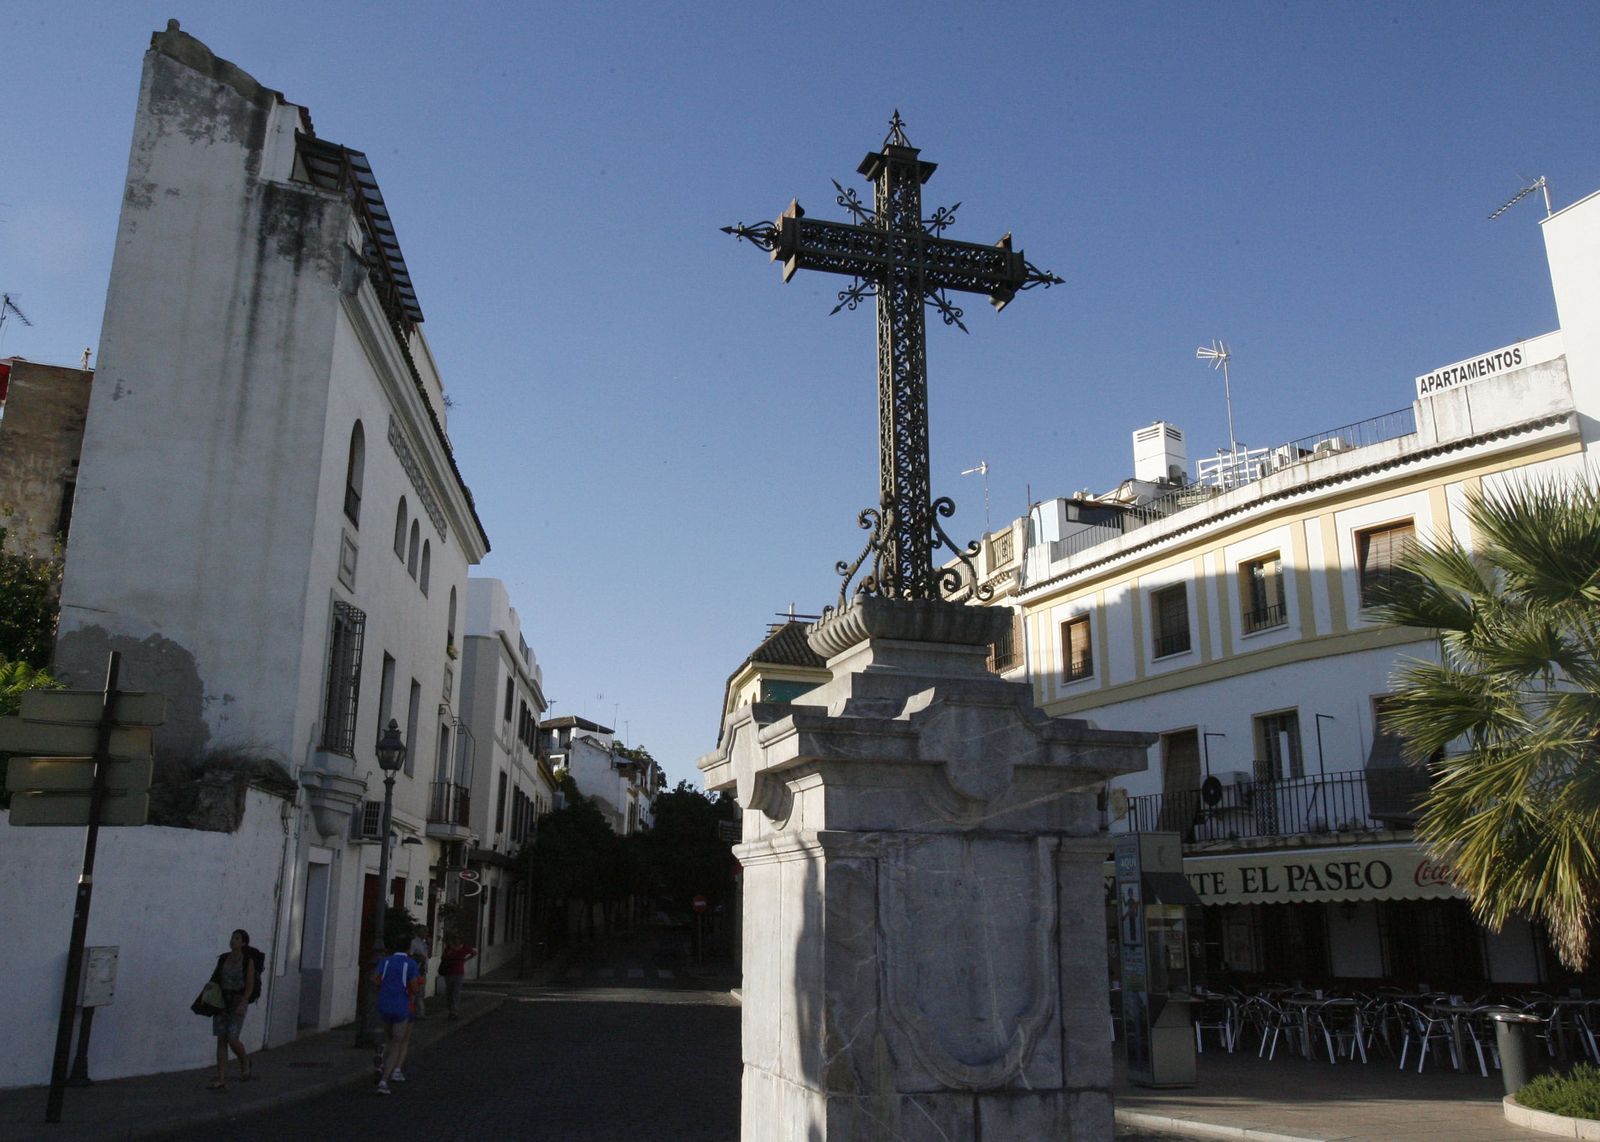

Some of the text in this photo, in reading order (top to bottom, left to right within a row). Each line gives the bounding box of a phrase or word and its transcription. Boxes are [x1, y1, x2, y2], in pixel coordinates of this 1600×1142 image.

[1420, 348, 1522, 395] APARTAMENTOS
[1239, 866, 1279, 894] EL
[1284, 860, 1393, 892] PASEO
